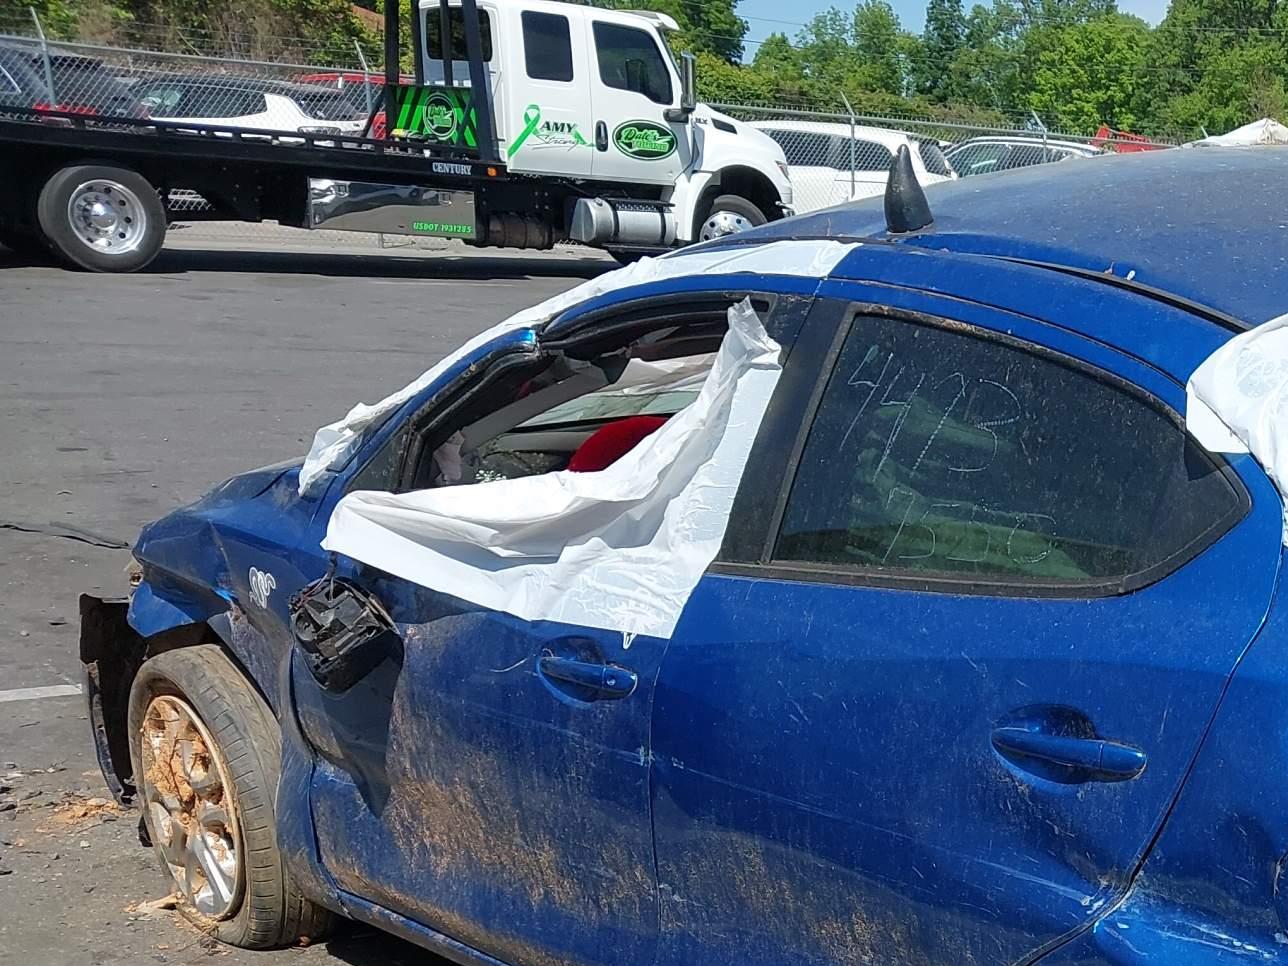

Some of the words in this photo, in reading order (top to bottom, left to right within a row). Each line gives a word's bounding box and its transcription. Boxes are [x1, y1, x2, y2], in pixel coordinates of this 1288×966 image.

[540, 121, 575, 133] AMY
[432, 162, 472, 175] CENTURY
[413, 222, 439, 231] USDOT
